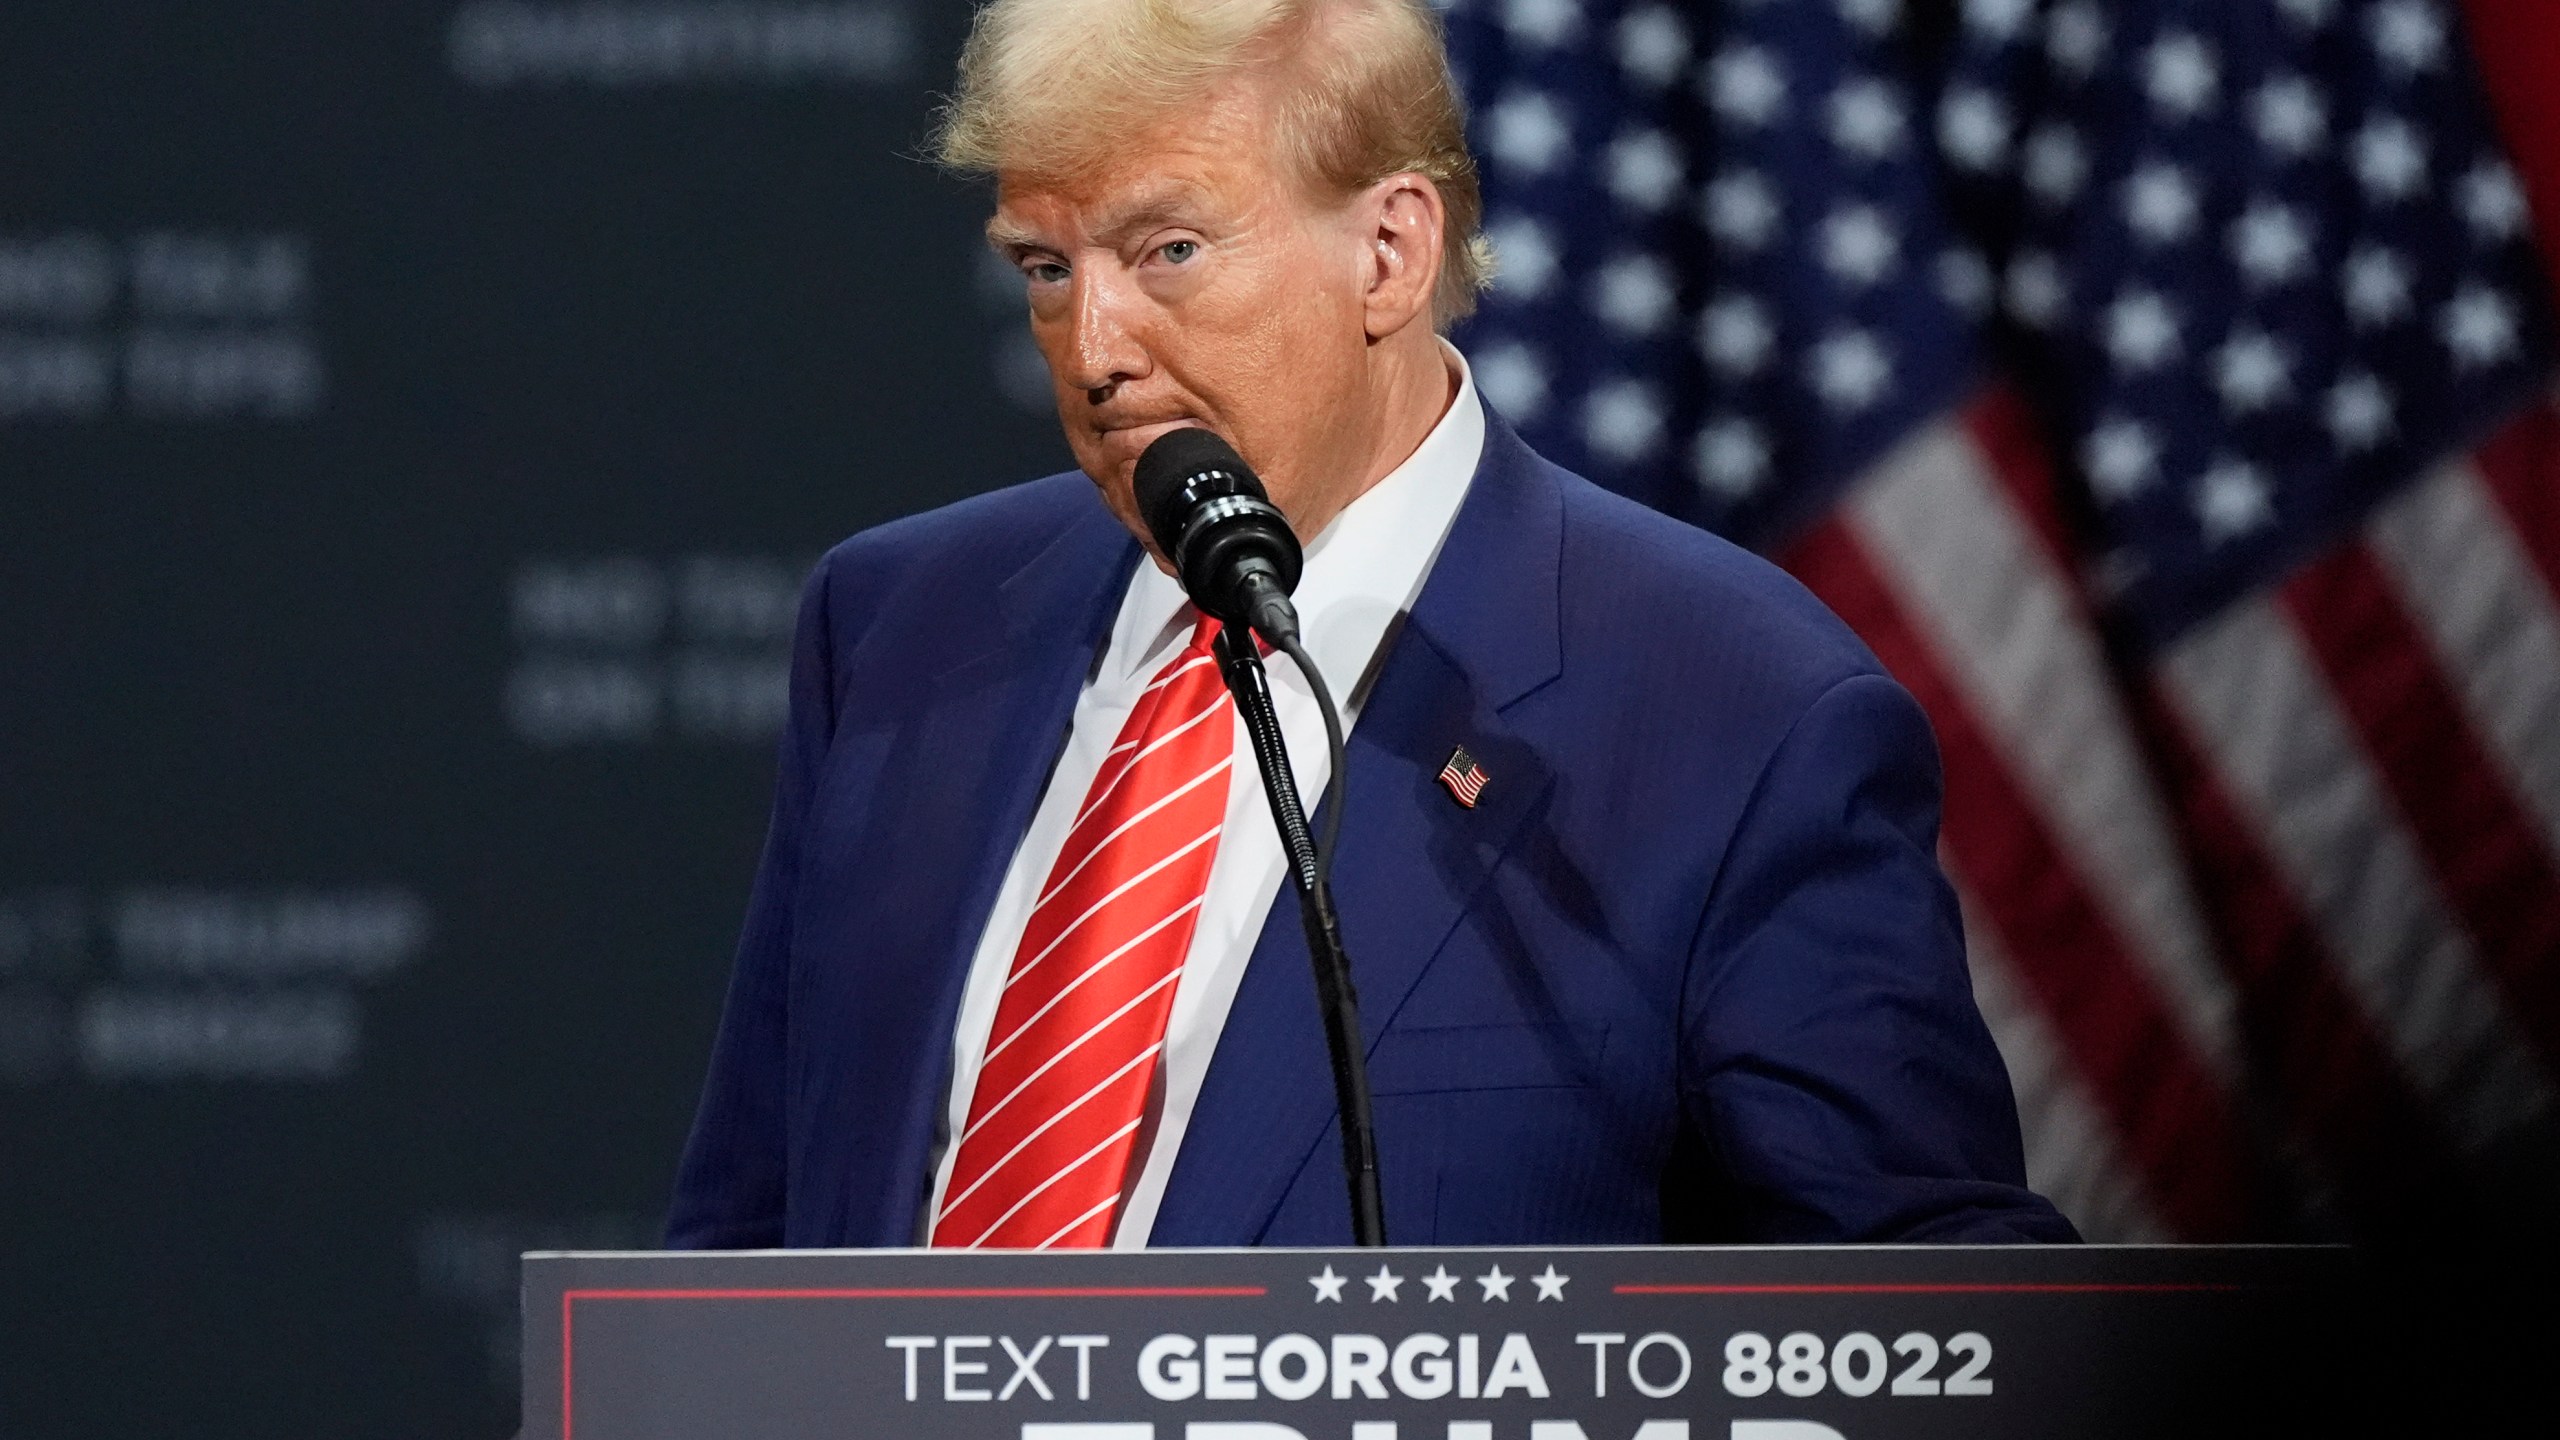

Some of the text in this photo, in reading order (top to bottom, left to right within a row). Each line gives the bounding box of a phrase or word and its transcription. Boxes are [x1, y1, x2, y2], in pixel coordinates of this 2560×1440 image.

[885, 1331, 1993, 1402] TEXT GEORGIA TO 88022
